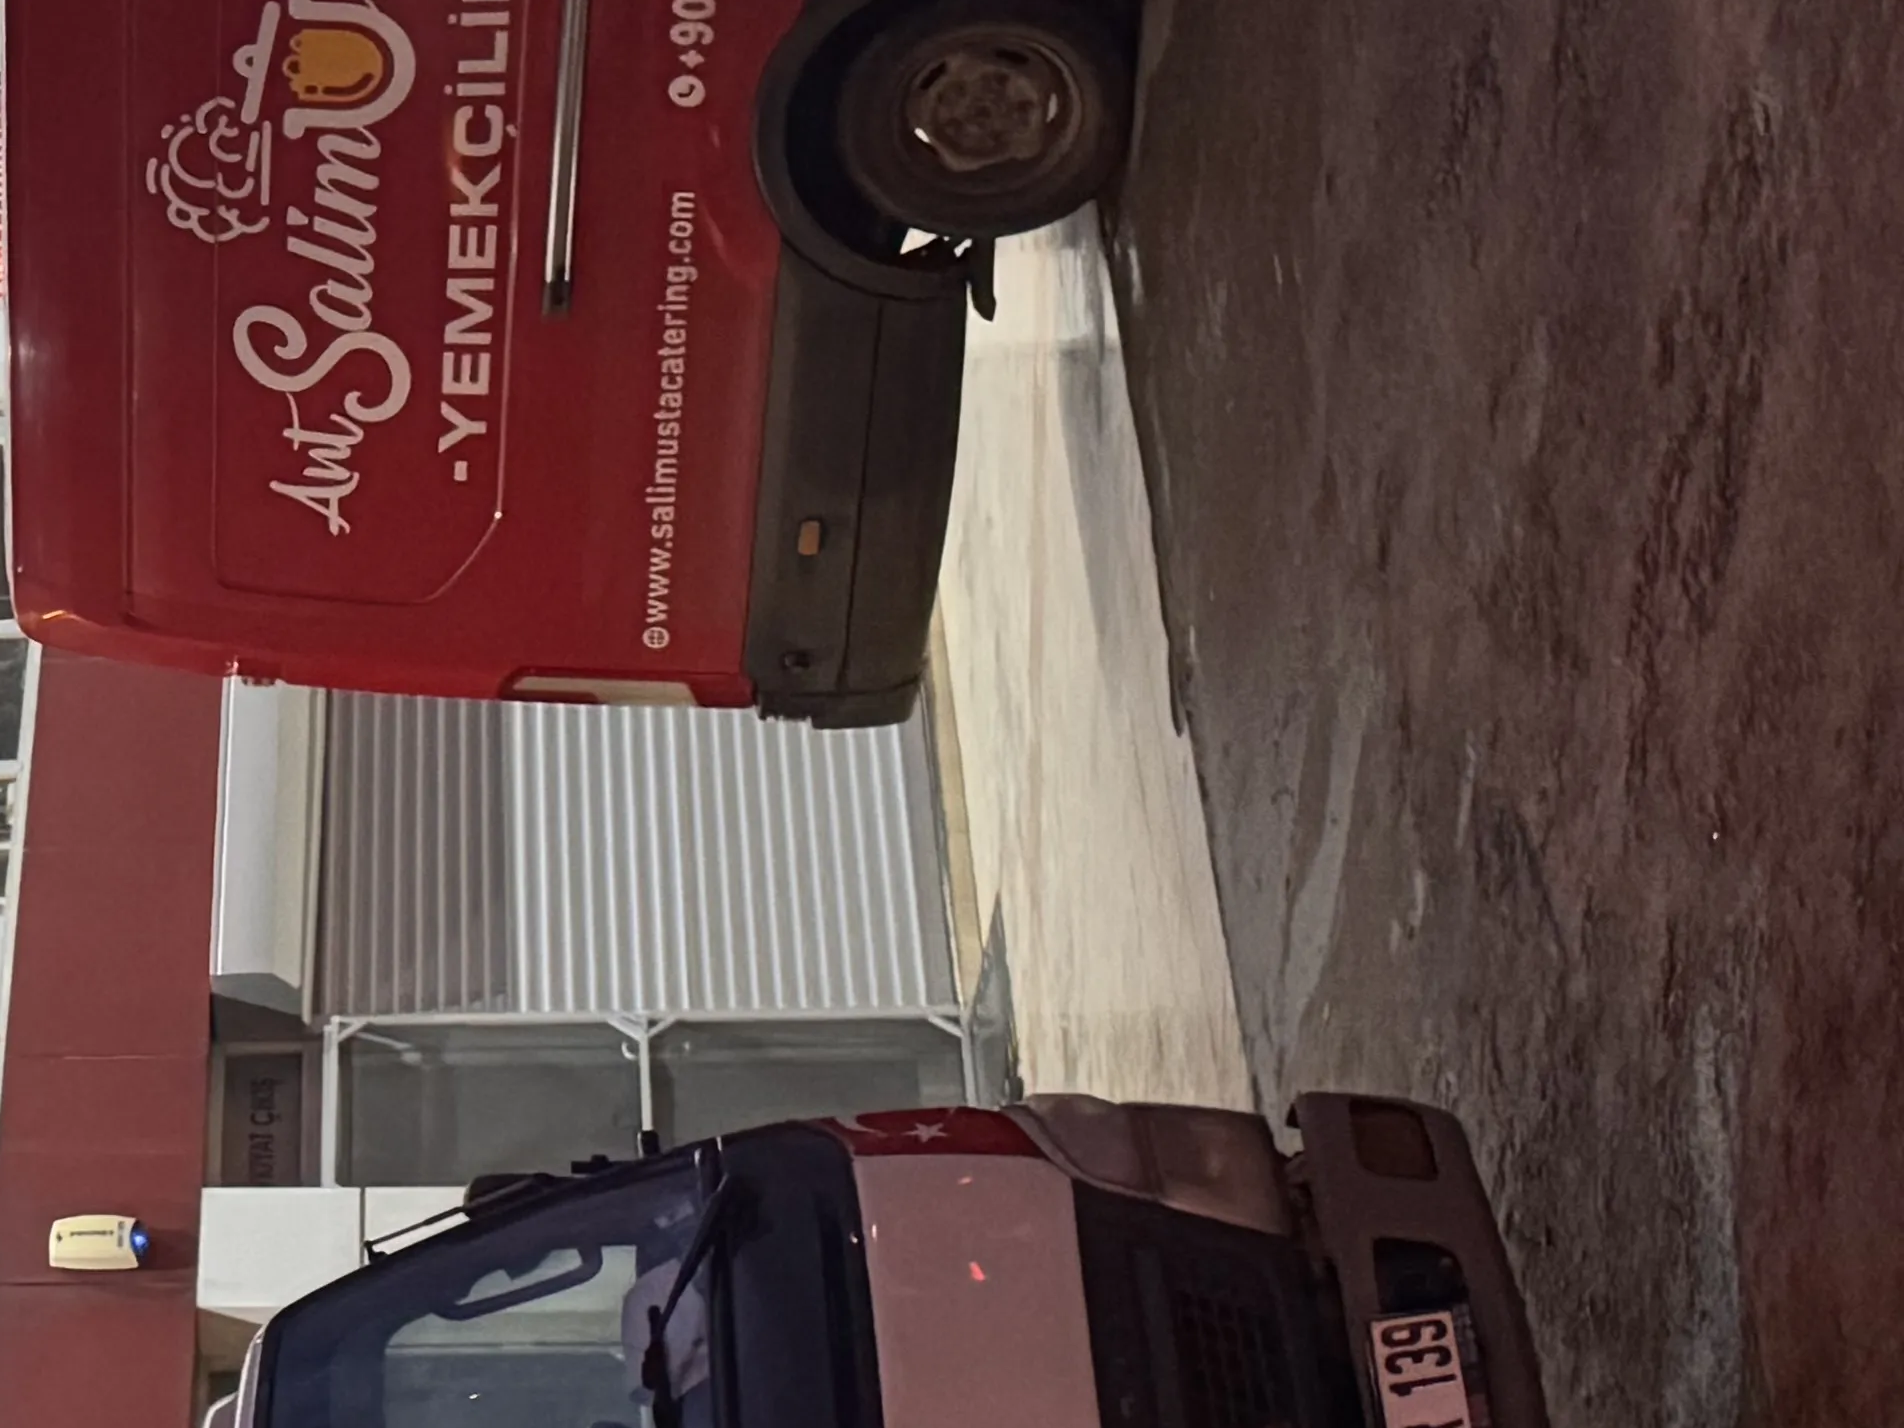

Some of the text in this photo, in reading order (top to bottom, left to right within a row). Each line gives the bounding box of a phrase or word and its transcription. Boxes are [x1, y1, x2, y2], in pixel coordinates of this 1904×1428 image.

[232, 118, 412, 423] Salim
[269, 390, 365, 535] Ant
[641, 190, 698, 624] www.salimustacatering.com
[1381, 1319, 1456, 1398] 139
